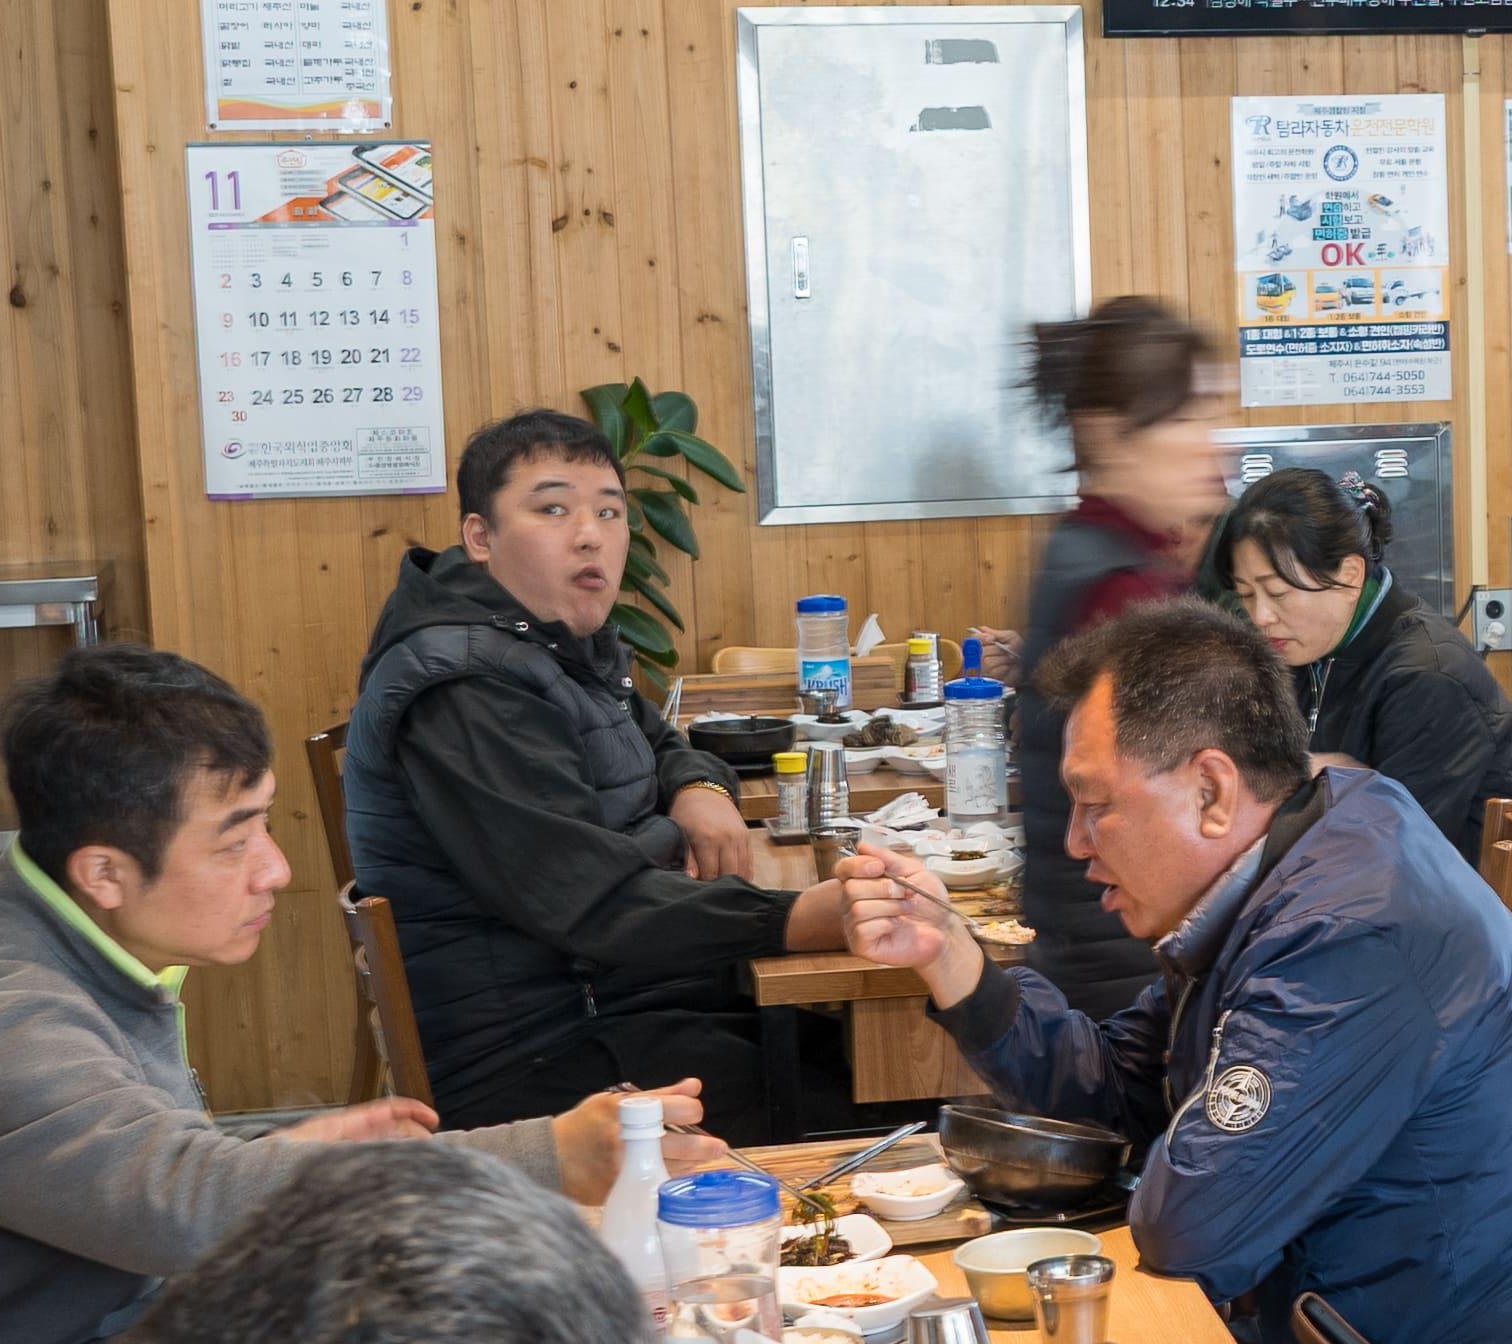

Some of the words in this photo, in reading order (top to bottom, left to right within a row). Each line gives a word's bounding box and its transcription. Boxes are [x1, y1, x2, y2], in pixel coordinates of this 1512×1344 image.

[205, 170, 241, 210] 11
[1321, 242, 1366, 267] OK
[220, 274, 232, 289] 2
[252, 274, 262, 288] 3
[281, 273, 293, 287] 4
[312, 272, 323, 287] 5
[342, 272, 352, 286] 6
[371, 271, 382, 286] 7
[401, 270, 412, 286] 8
[223, 314, 233, 328] 9
[249, 312, 269, 327] 10
[279, 312, 297, 327] 11
[310, 311, 330, 326] 12
[340, 311, 360, 326] 13
[370, 310, 390, 325] 14
[400, 309, 420, 324] 15
[220, 353, 241, 367] 16
[251, 352, 271, 367] 17
[281, 351, 301, 366] 18
[312, 351, 331, 365] 19
[341, 350, 361, 364] 20
[370, 349, 391, 364] 21
[400, 348, 421, 363] 22
[219, 391, 233, 402] 23
[252, 390, 273, 405] 24
[282, 390, 303, 404] 25
[312, 389, 333, 404] 26
[342, 388, 363, 403] 27
[372, 388, 393, 402] 28
[403, 386, 423, 401] 29
[232, 411, 247, 422] 30
